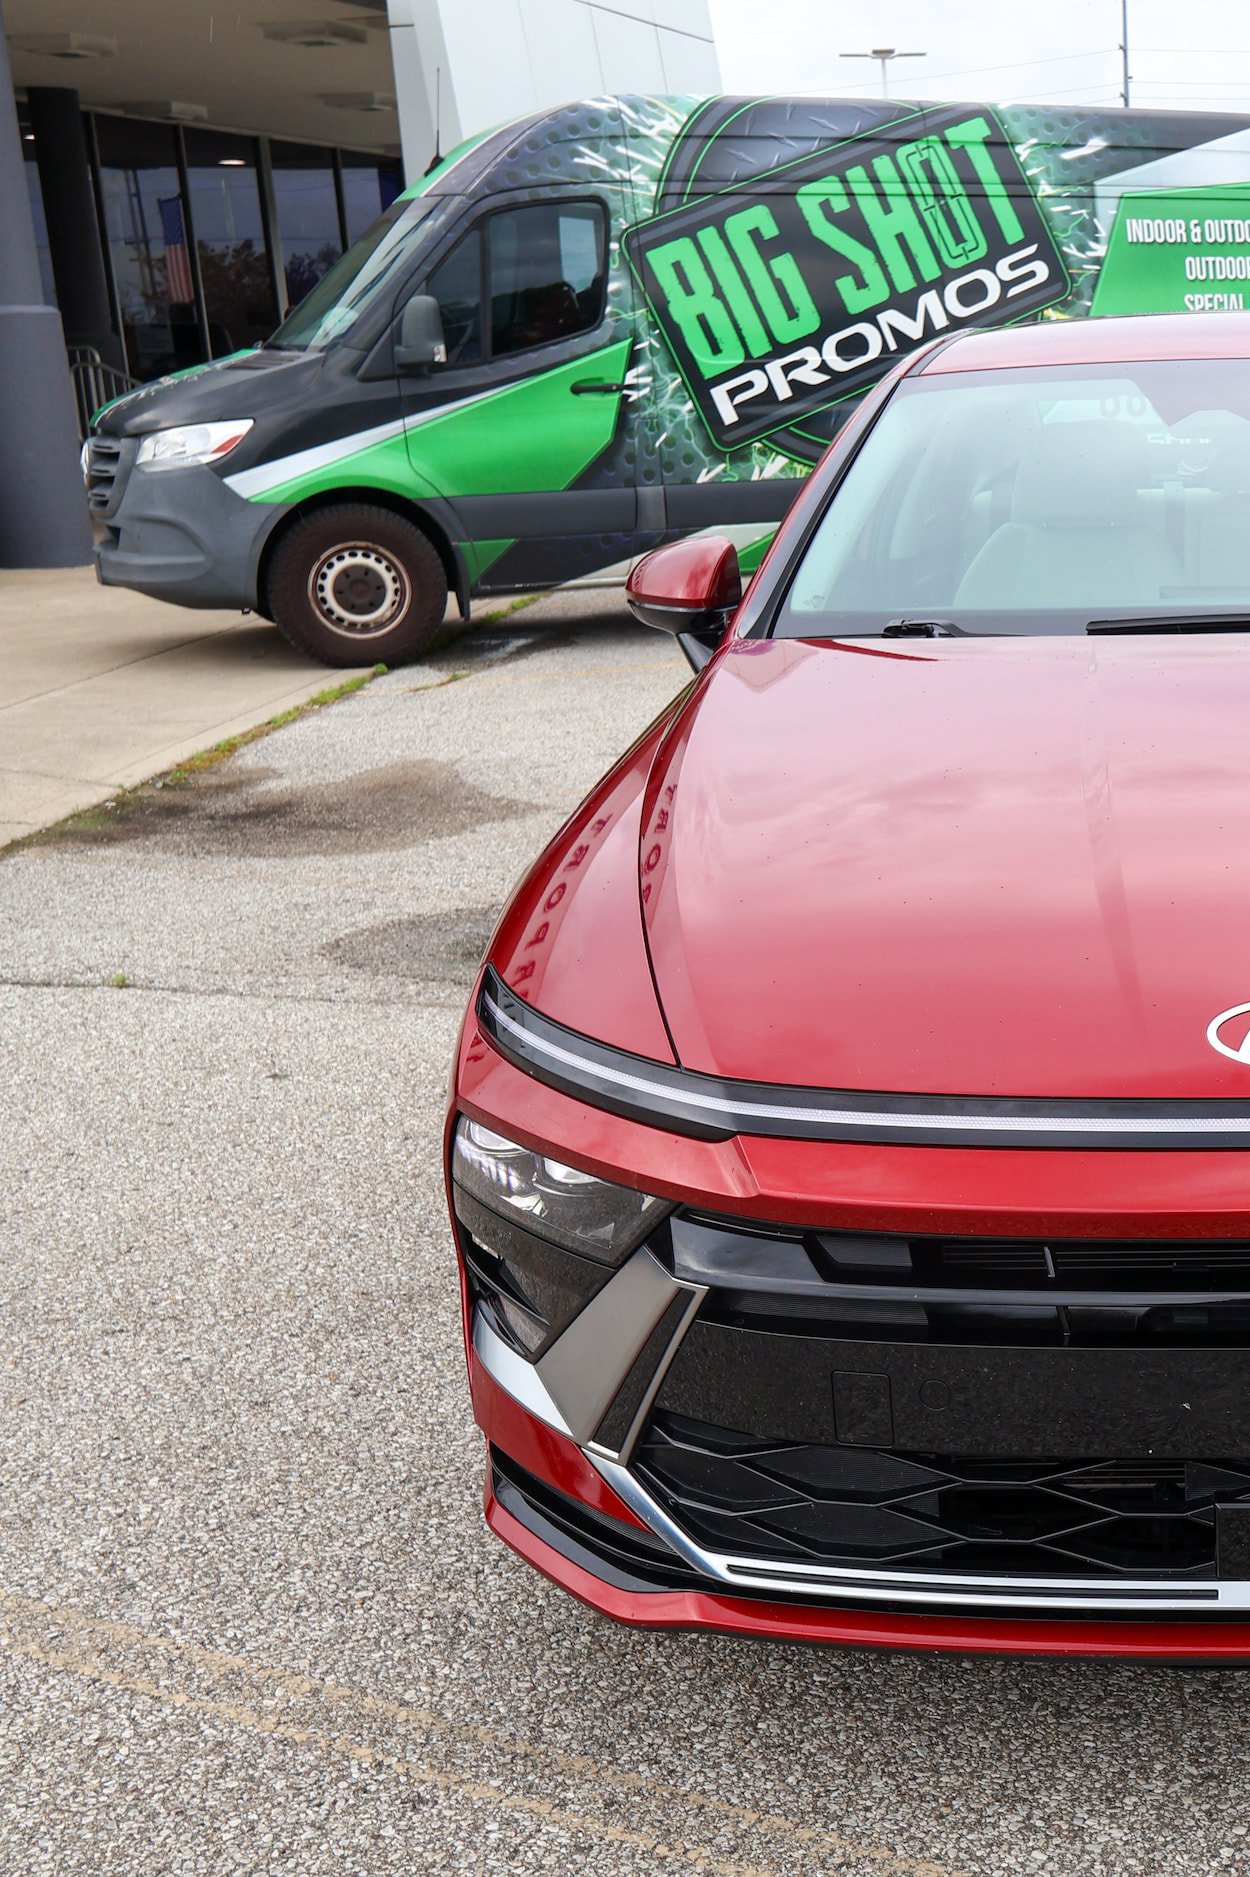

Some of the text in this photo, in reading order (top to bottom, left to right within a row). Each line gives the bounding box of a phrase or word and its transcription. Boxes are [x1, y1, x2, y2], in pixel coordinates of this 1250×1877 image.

[646, 117, 1025, 380] BIG SHOT
[1126, 219, 1187, 243] INDOOR
[1190, 219, 1202, 243] &
[710, 244, 1049, 426] PROMOS
[1184, 293, 1244, 311] SPECIAL
